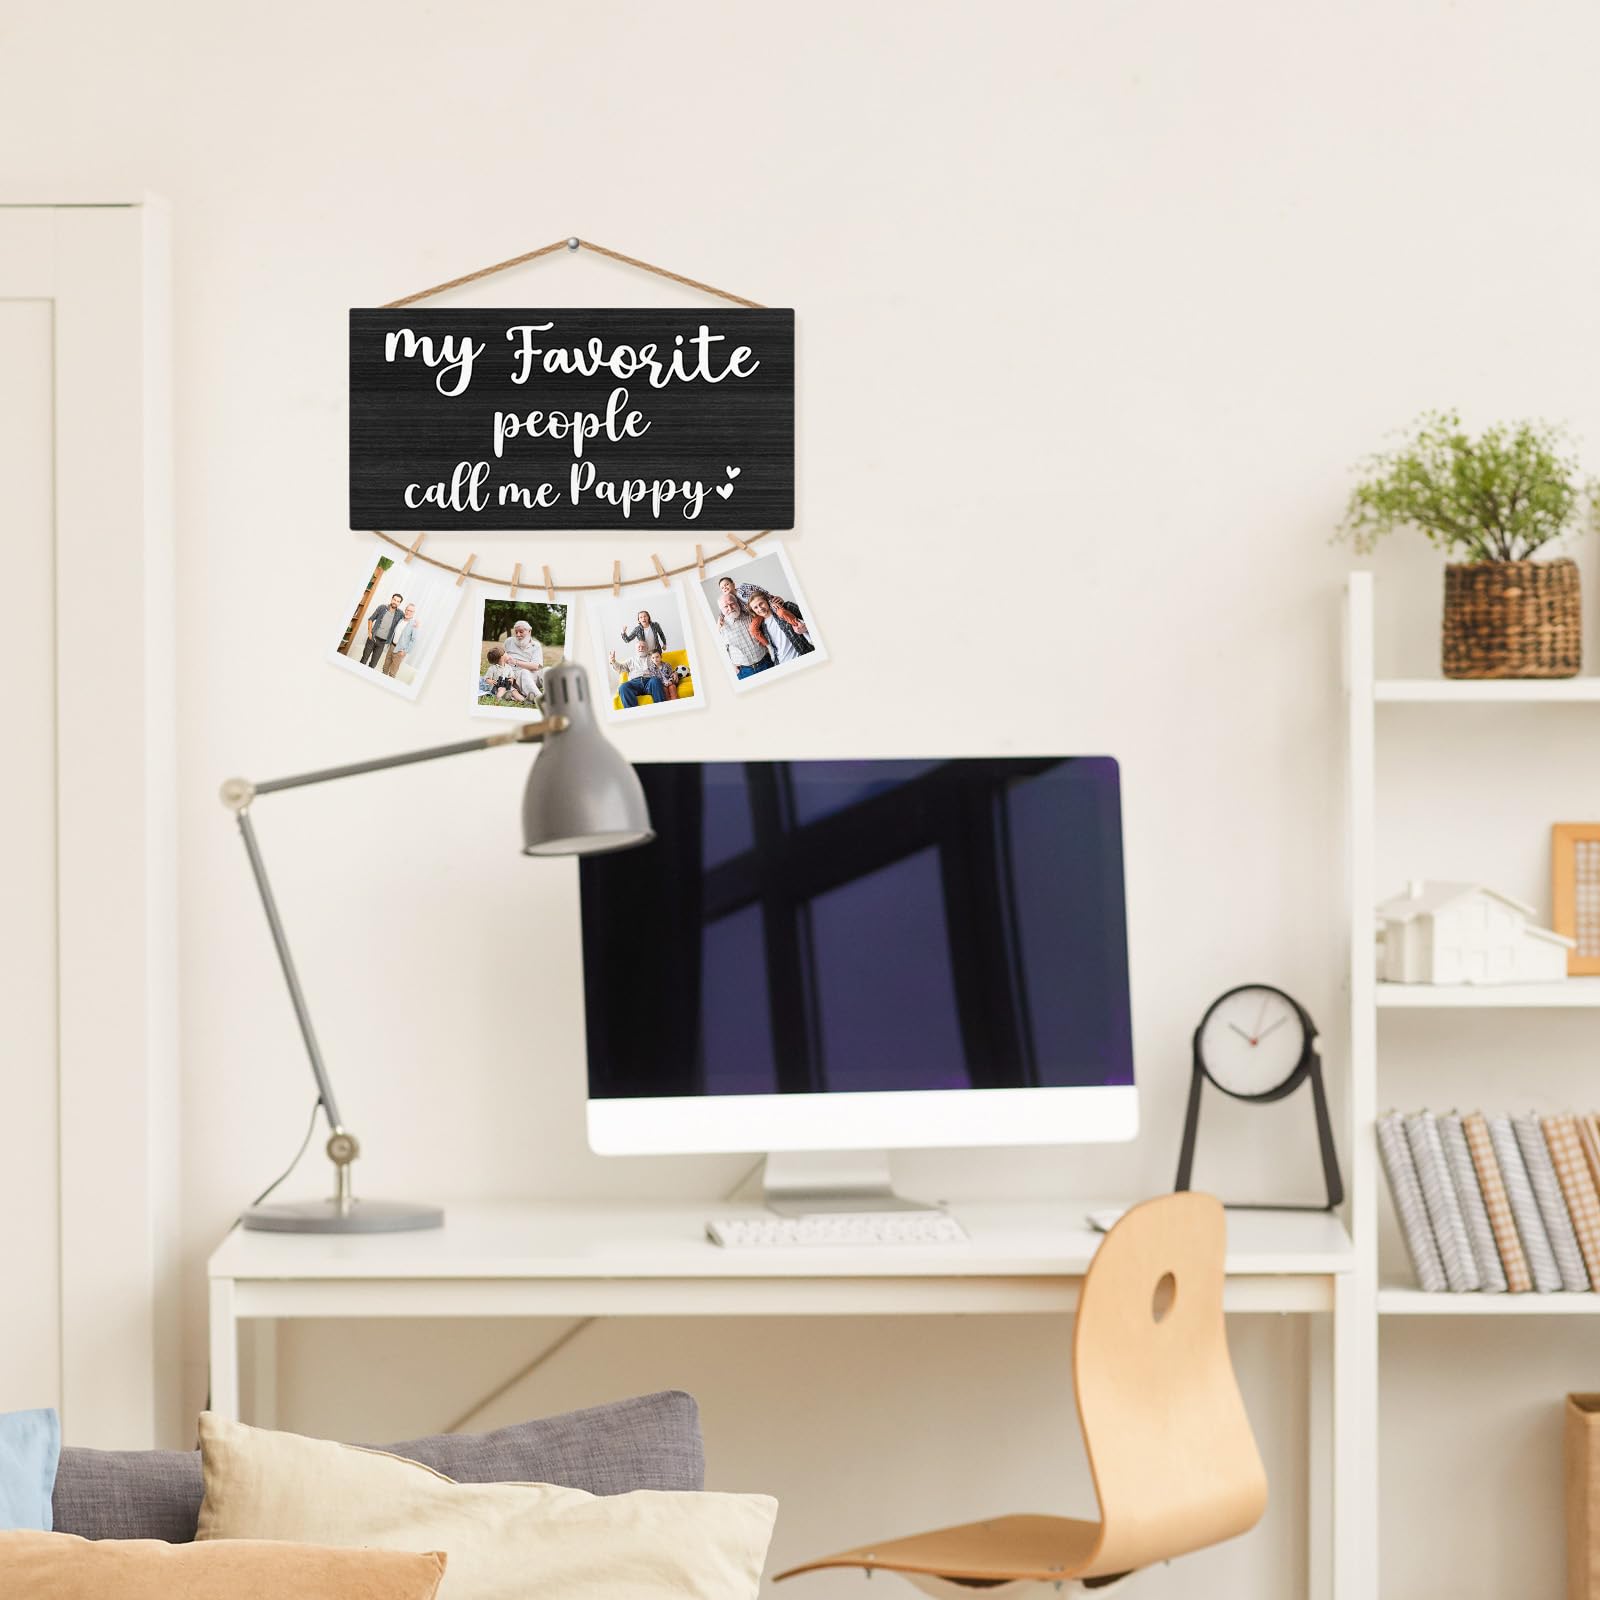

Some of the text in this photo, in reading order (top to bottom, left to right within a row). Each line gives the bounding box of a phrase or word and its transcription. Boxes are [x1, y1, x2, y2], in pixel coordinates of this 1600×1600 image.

[385, 322, 761, 397] my Favorite
[493, 387, 652, 458] people
[404, 461, 713, 520] call me Pappy
